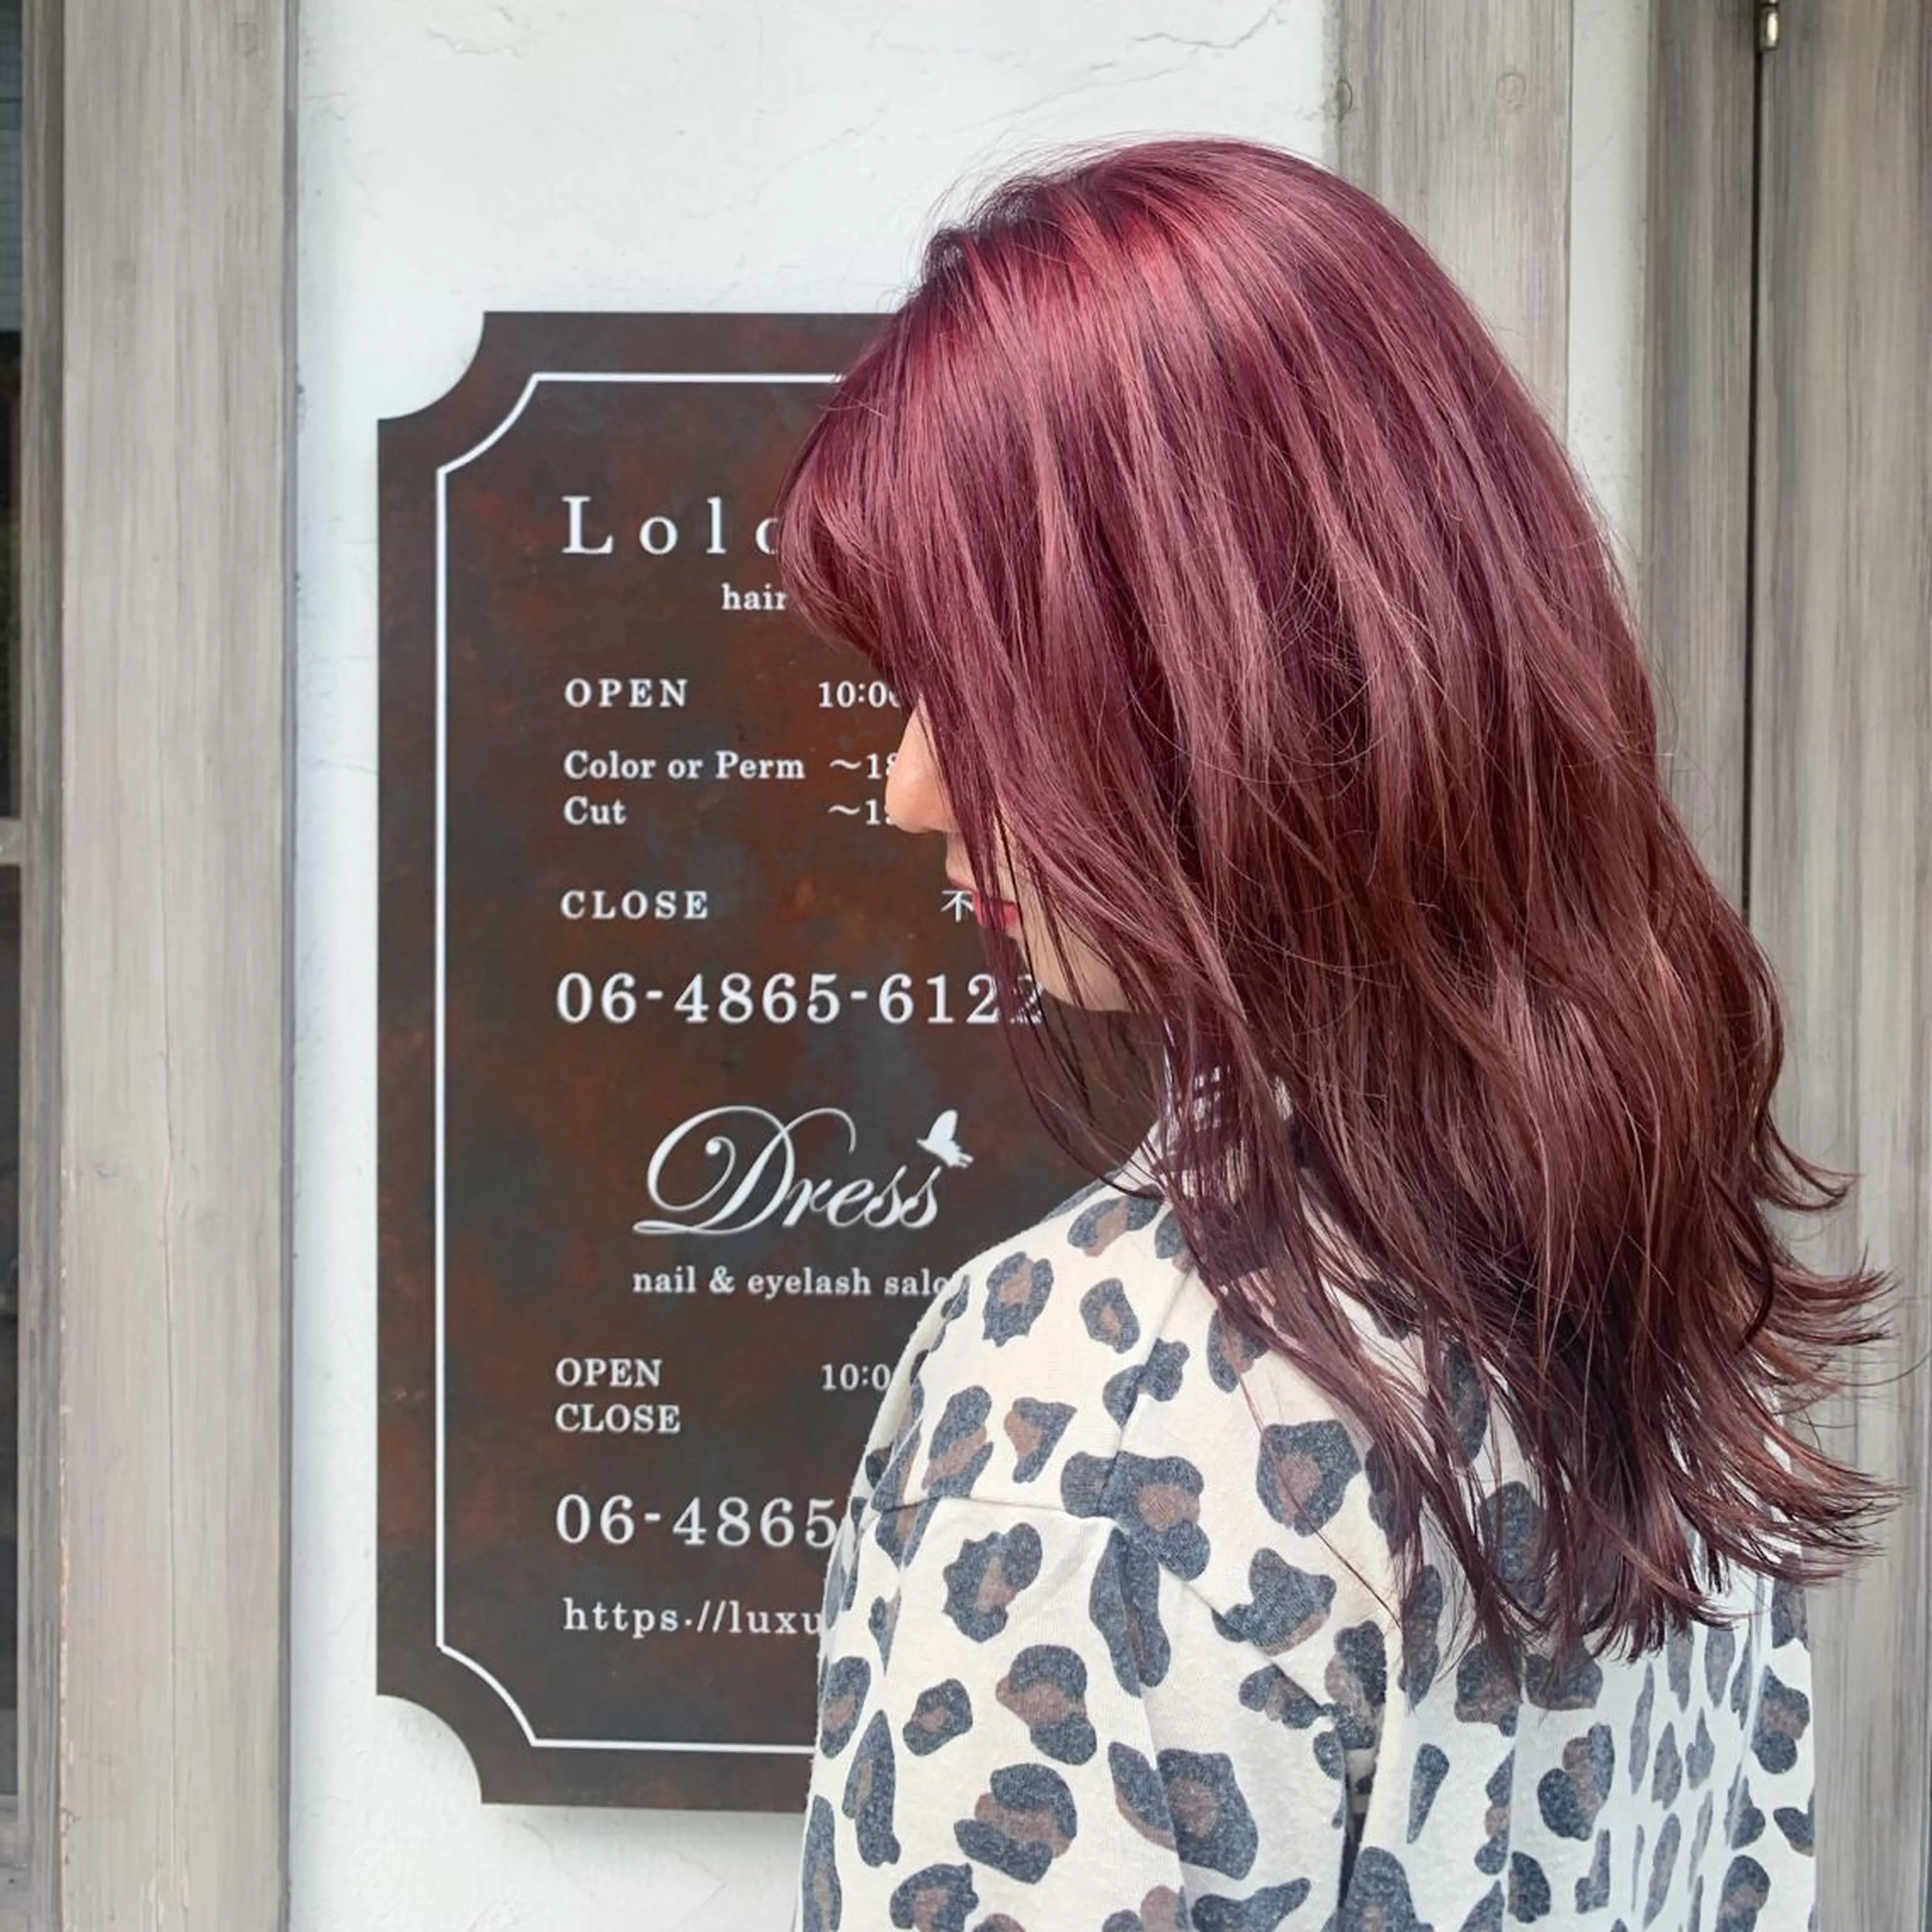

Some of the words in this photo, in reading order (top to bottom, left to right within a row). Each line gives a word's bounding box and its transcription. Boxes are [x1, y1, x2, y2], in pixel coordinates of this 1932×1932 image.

[721, 582, 788, 611] hair
[565, 678, 688, 708] OPEN
[564, 750, 657, 779] Color
[667, 759, 703, 779] or
[715, 750, 805, 779] Perm
[563, 795, 627, 825] Cut
[560, 890, 708, 919] CLOSE
[632, 1105, 942, 1235] Dress
[633, 1265, 696, 1294] nail
[708, 1265, 735, 1294] &
[747, 1266, 871, 1300] eyelash
[555, 1357, 663, 1388] OPEN
[555, 1403, 681, 1434] CLOSE
[556, 1493, 837, 1548] 06-4865
